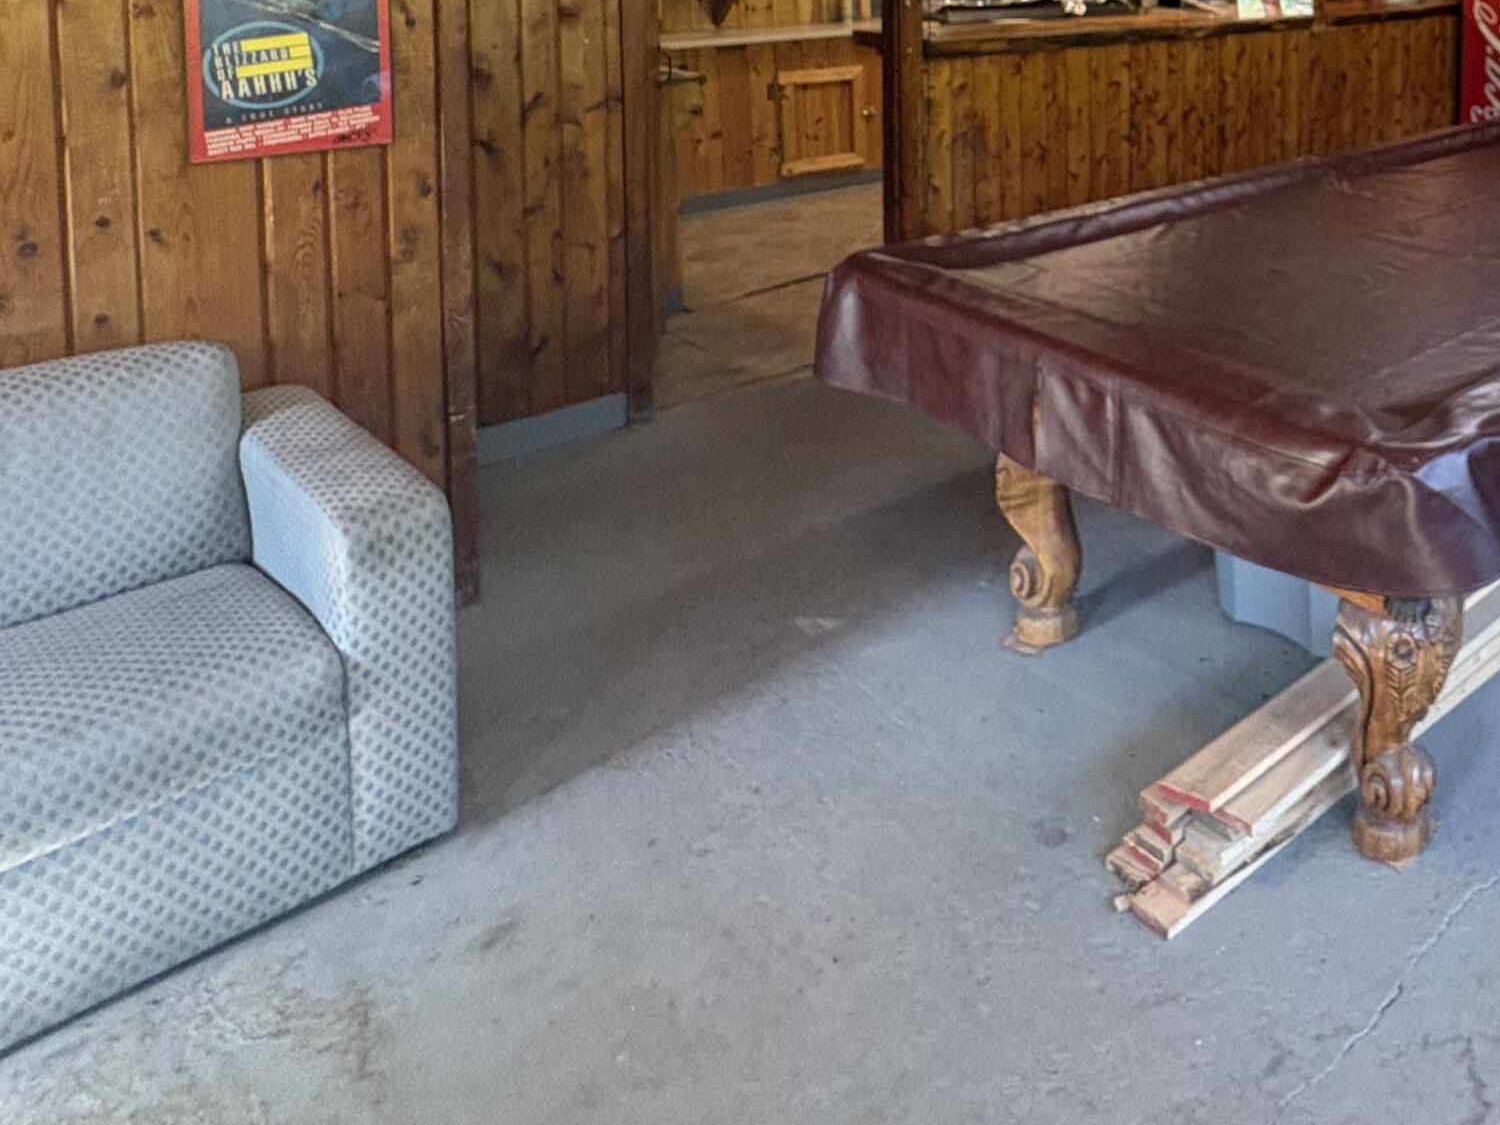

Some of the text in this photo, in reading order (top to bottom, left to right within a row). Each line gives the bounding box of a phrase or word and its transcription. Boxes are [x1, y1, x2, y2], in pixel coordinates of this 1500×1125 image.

[212, 41, 240, 56] THE
[214, 47, 288, 69] BLIZZARD
[217, 66, 235, 81] OF
[222, 67, 318, 100] AAHHH'S
